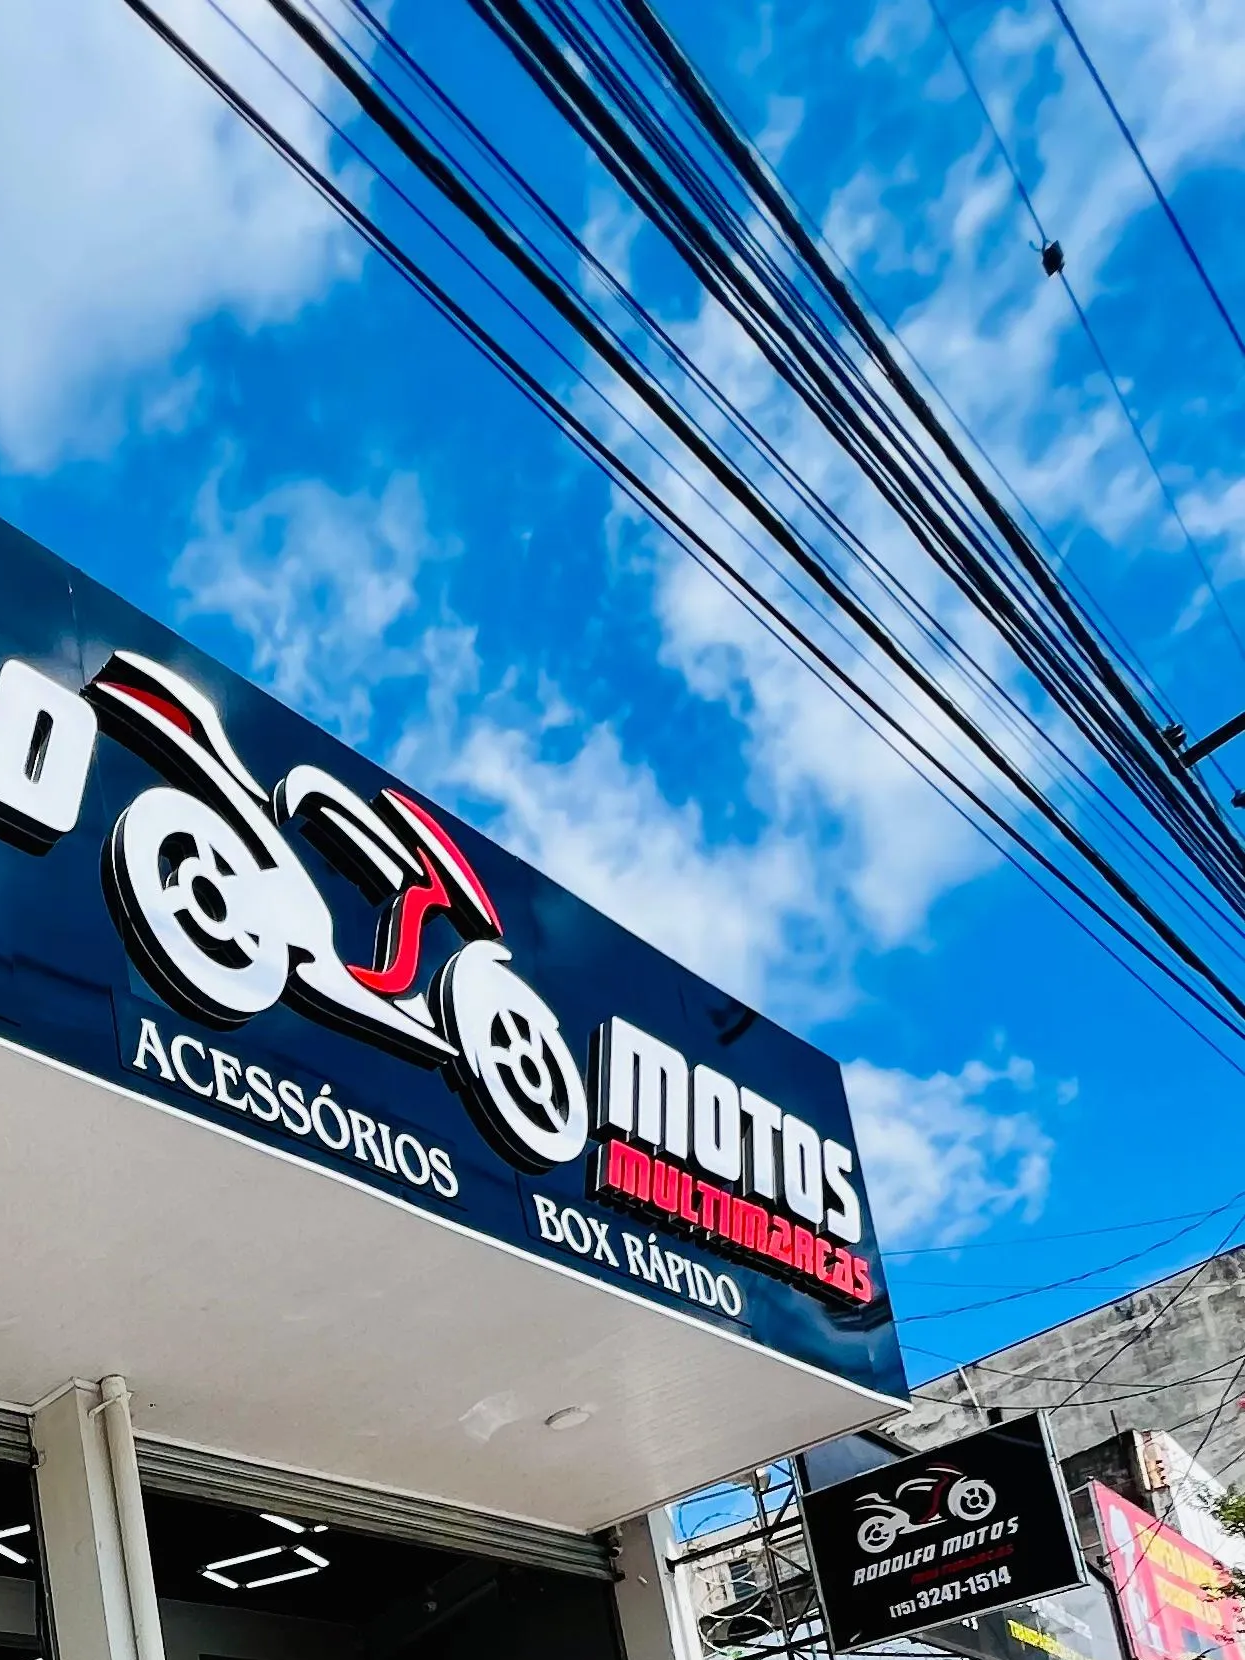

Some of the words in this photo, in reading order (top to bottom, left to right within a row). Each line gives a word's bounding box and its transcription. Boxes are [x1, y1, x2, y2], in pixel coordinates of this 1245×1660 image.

[132, 1017, 459, 1198] ACESSÓRIOS
[607, 1014, 862, 1246] MOTOS
[532, 1193, 620, 1268] BOX
[620, 1231, 743, 1317] RÁPIDO
[852, 1543, 936, 1586] RODOLFO
[940, 1515, 1020, 1557] MOTOS
[916, 1565, 1012, 1610] 3247-1514
